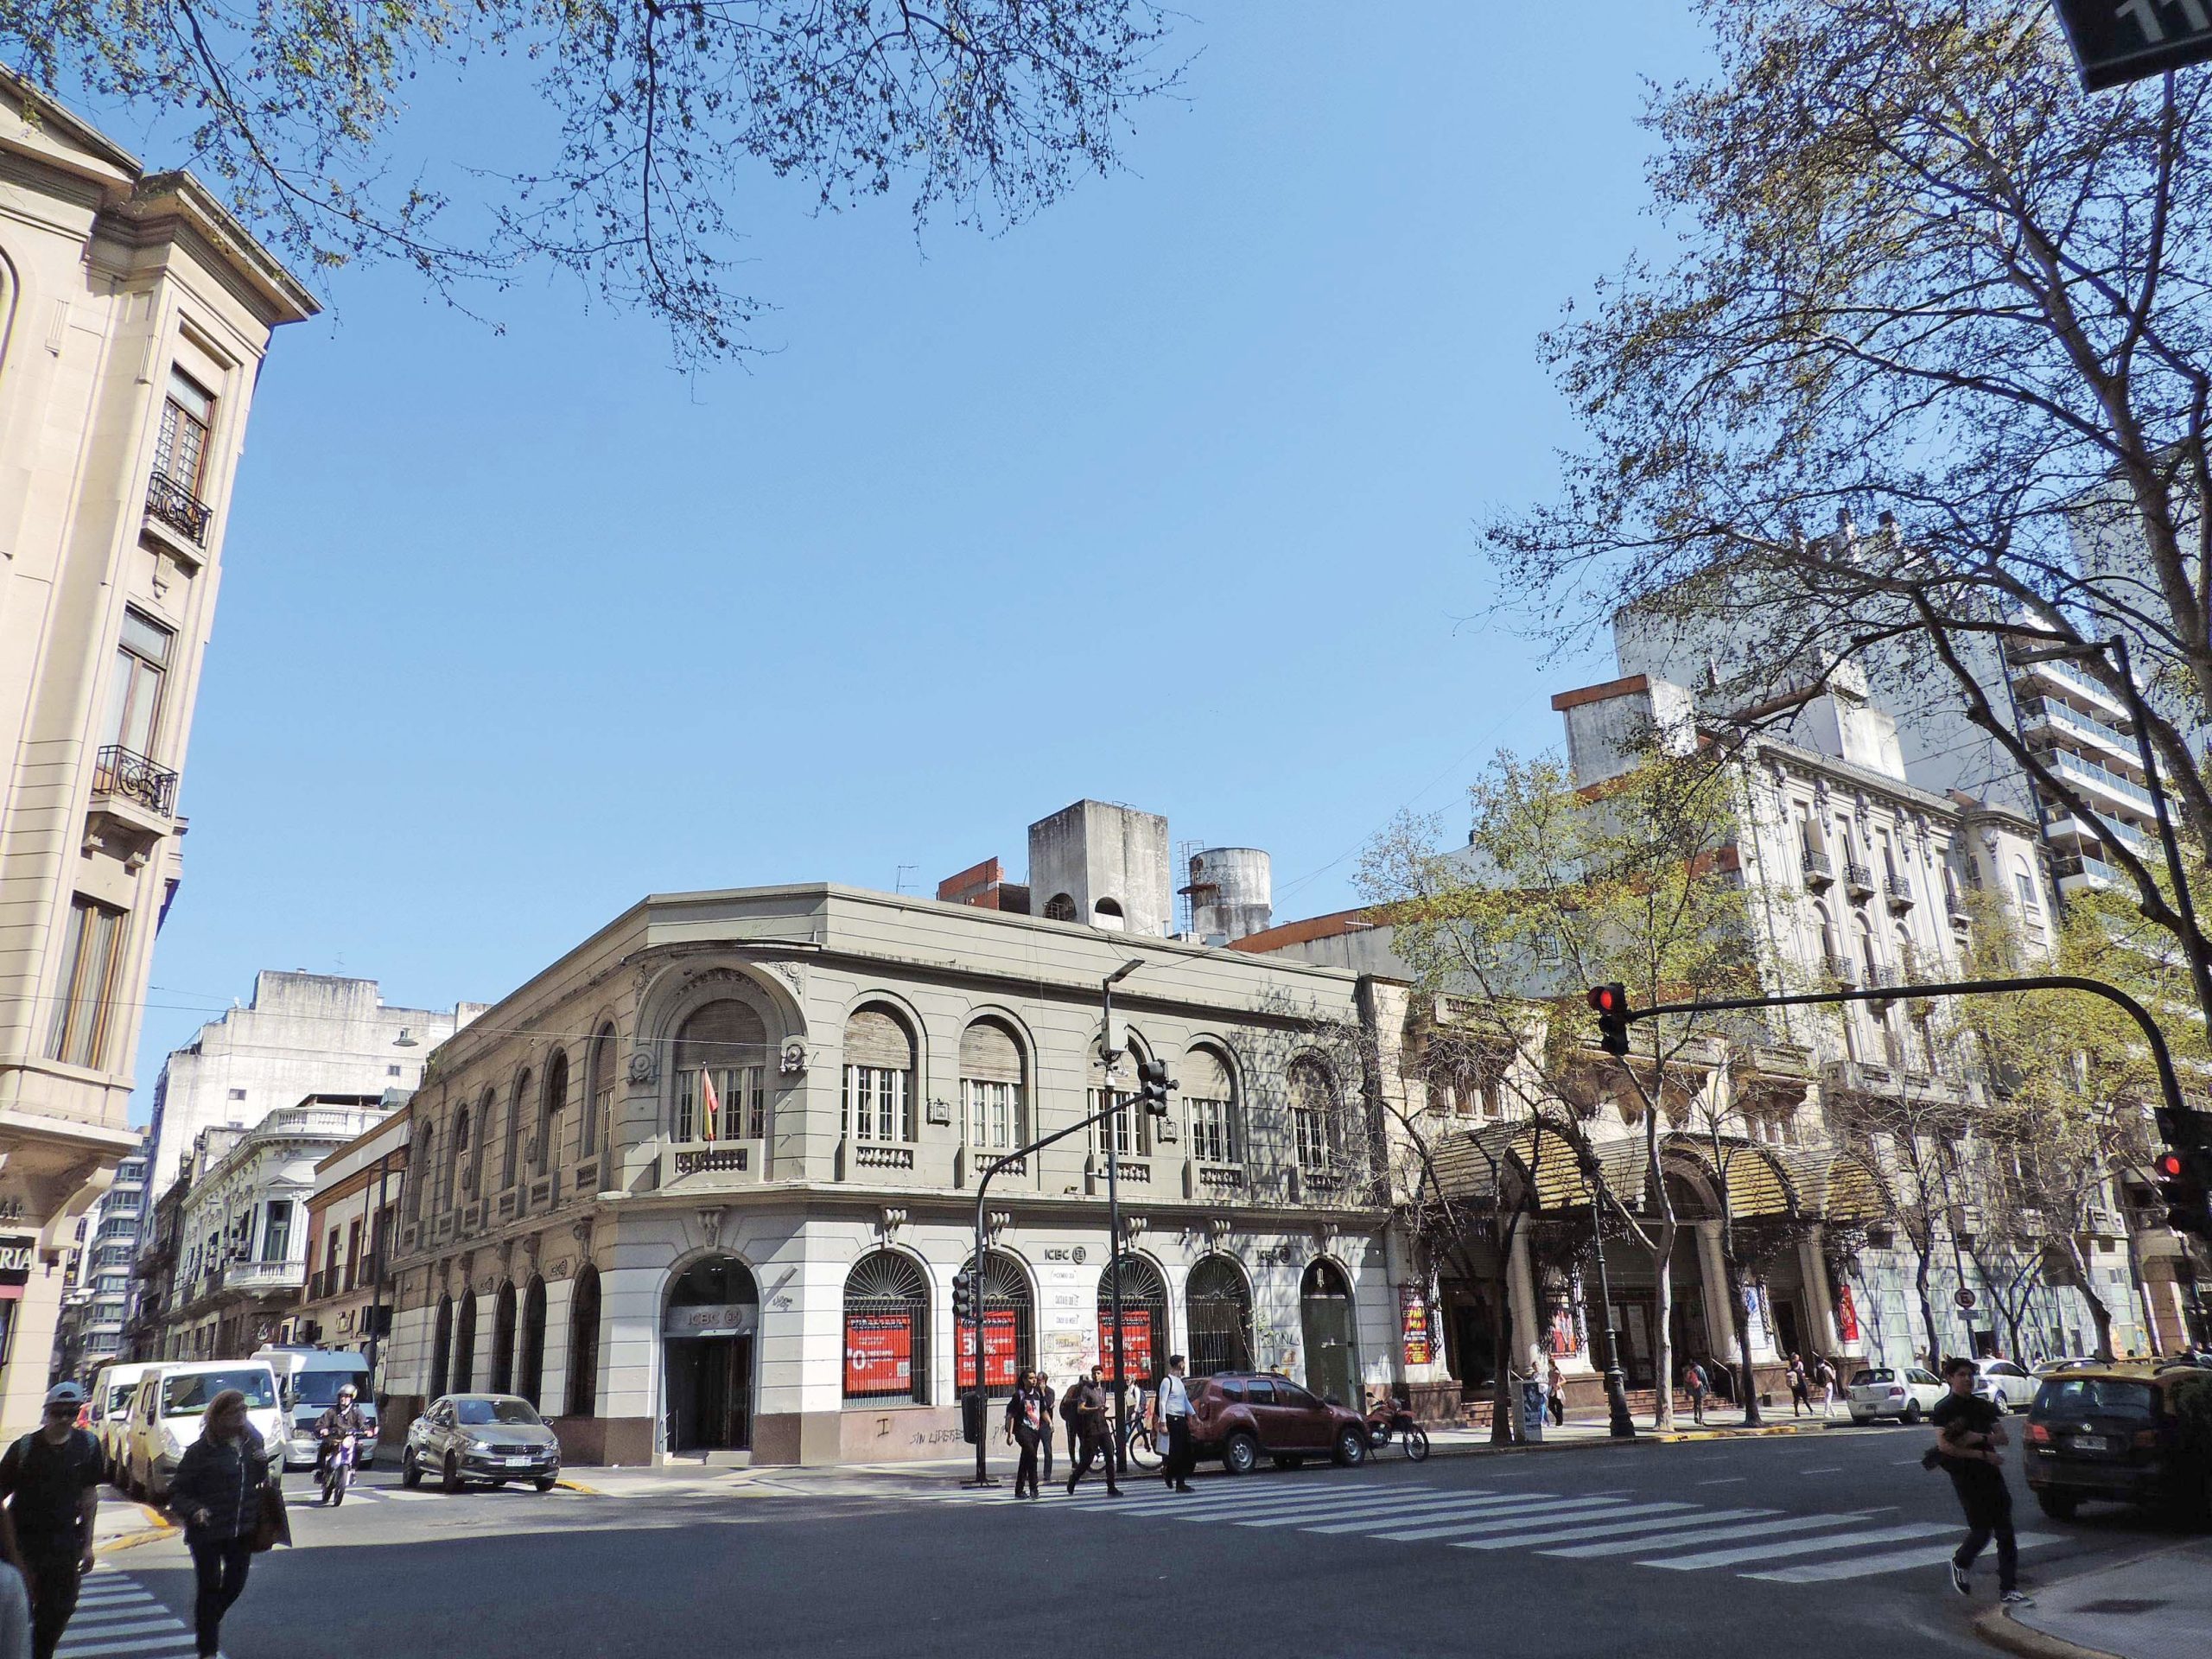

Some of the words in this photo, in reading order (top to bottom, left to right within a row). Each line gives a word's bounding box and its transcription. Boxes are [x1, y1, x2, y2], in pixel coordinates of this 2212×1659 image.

[1045, 1249, 1070, 1261] ICBC
[689, 1312, 720, 1325] ICBC
[910, 1431, 925, 1445] SIN
